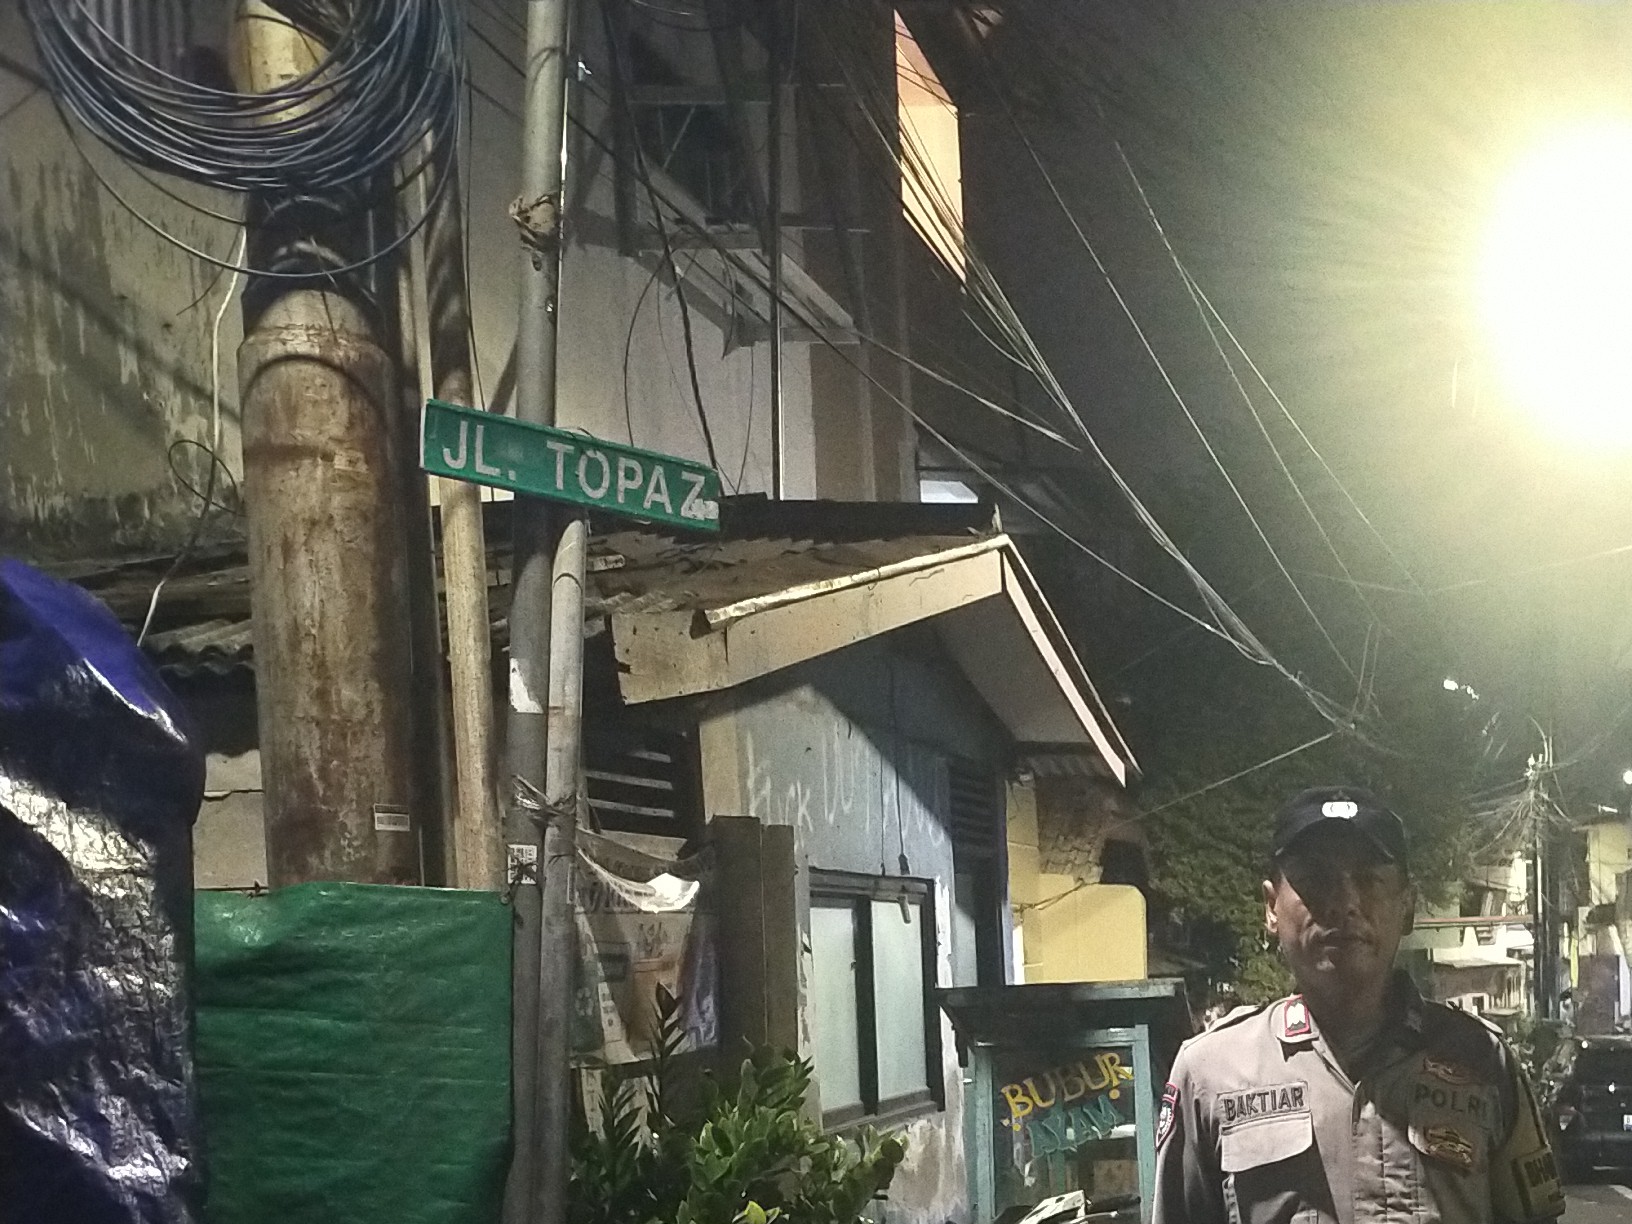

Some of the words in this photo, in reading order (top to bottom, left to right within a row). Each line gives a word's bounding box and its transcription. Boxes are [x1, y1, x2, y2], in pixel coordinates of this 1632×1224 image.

[441, 419, 517, 482] JL.
[546, 440, 707, 521] TOPAZ
[1001, 1052, 1134, 1119] BUBUR
[1223, 1086, 1304, 1121] BAKTIAR
